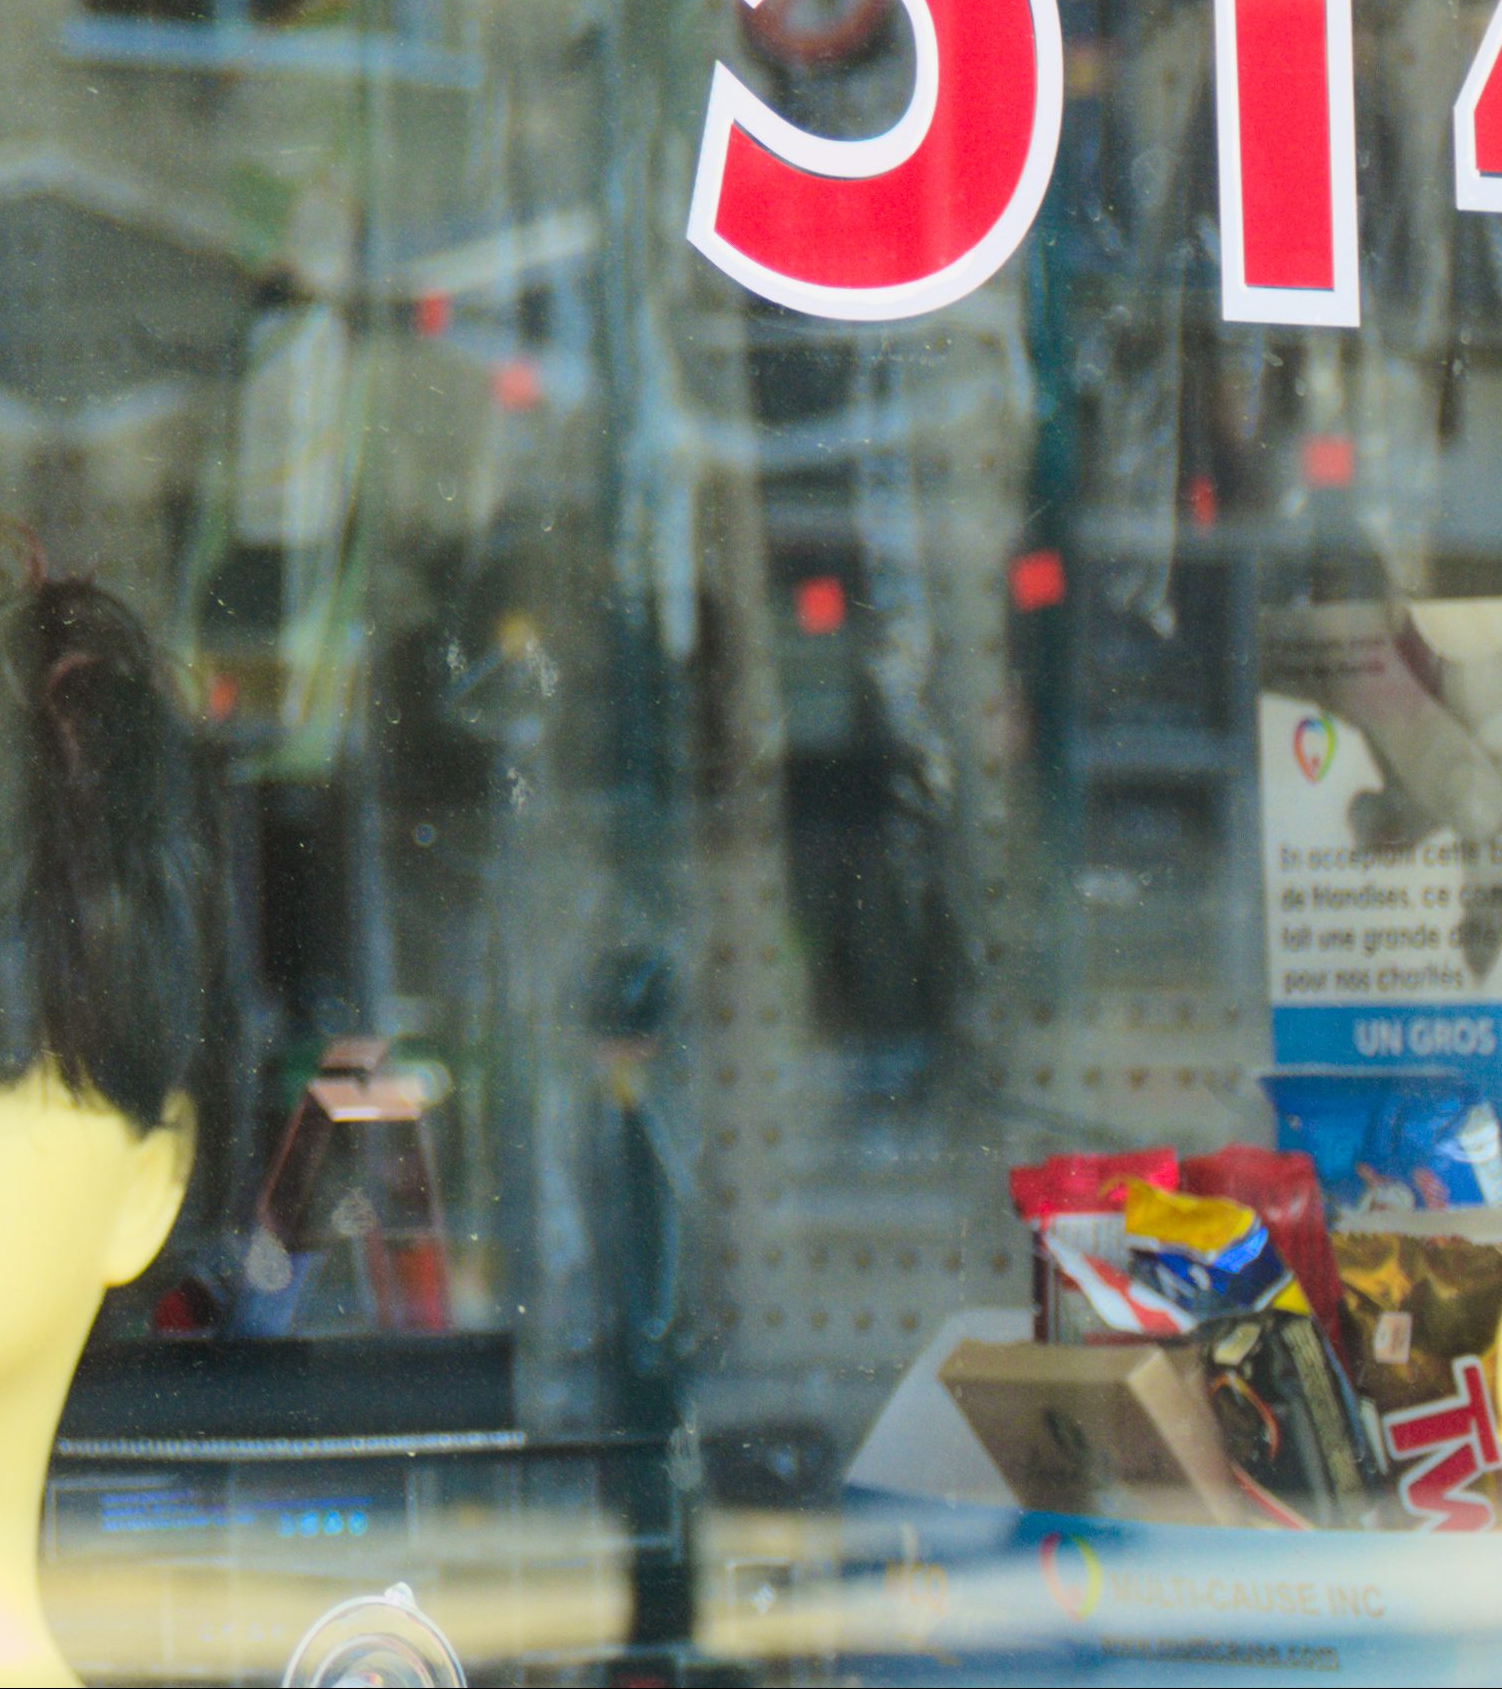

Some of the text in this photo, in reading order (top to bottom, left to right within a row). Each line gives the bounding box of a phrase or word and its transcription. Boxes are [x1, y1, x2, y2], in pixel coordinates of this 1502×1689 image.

[1282, 886, 1305, 910] de
[1421, 887, 1449, 908] ce
[1354, 1017, 1497, 1057] UN GROS
[1109, 1572, 1386, 1619] MULTI-CAUSE INC
